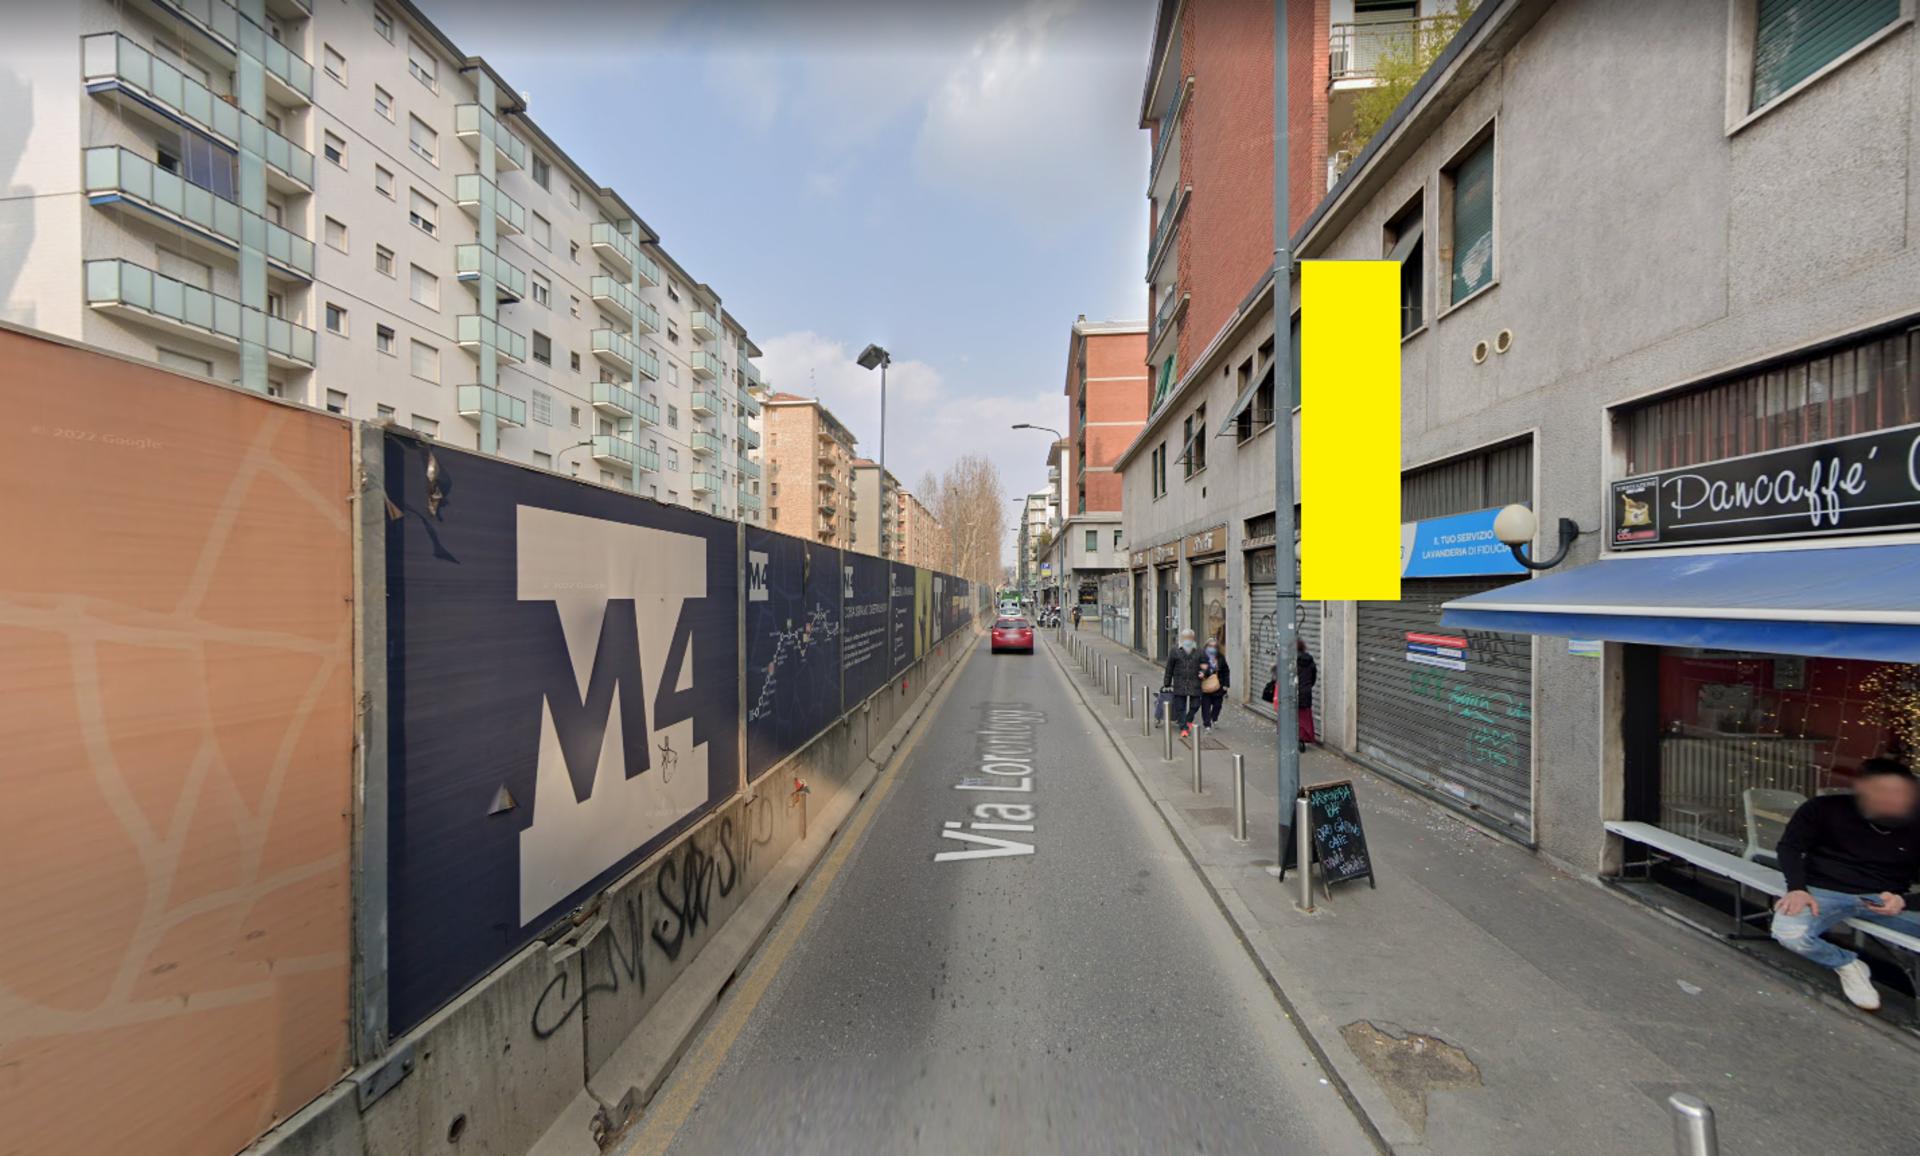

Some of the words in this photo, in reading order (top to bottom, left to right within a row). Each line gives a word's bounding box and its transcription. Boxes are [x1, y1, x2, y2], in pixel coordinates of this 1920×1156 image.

[1441, 534, 1457, 545] TUO
[1457, 530, 1494, 543] SERVIZIO
[1422, 547, 1467, 559] LAVANDERIA
[1468, 546, 1478, 556] DI
[1479, 543, 1511, 555] FIDUCIA
